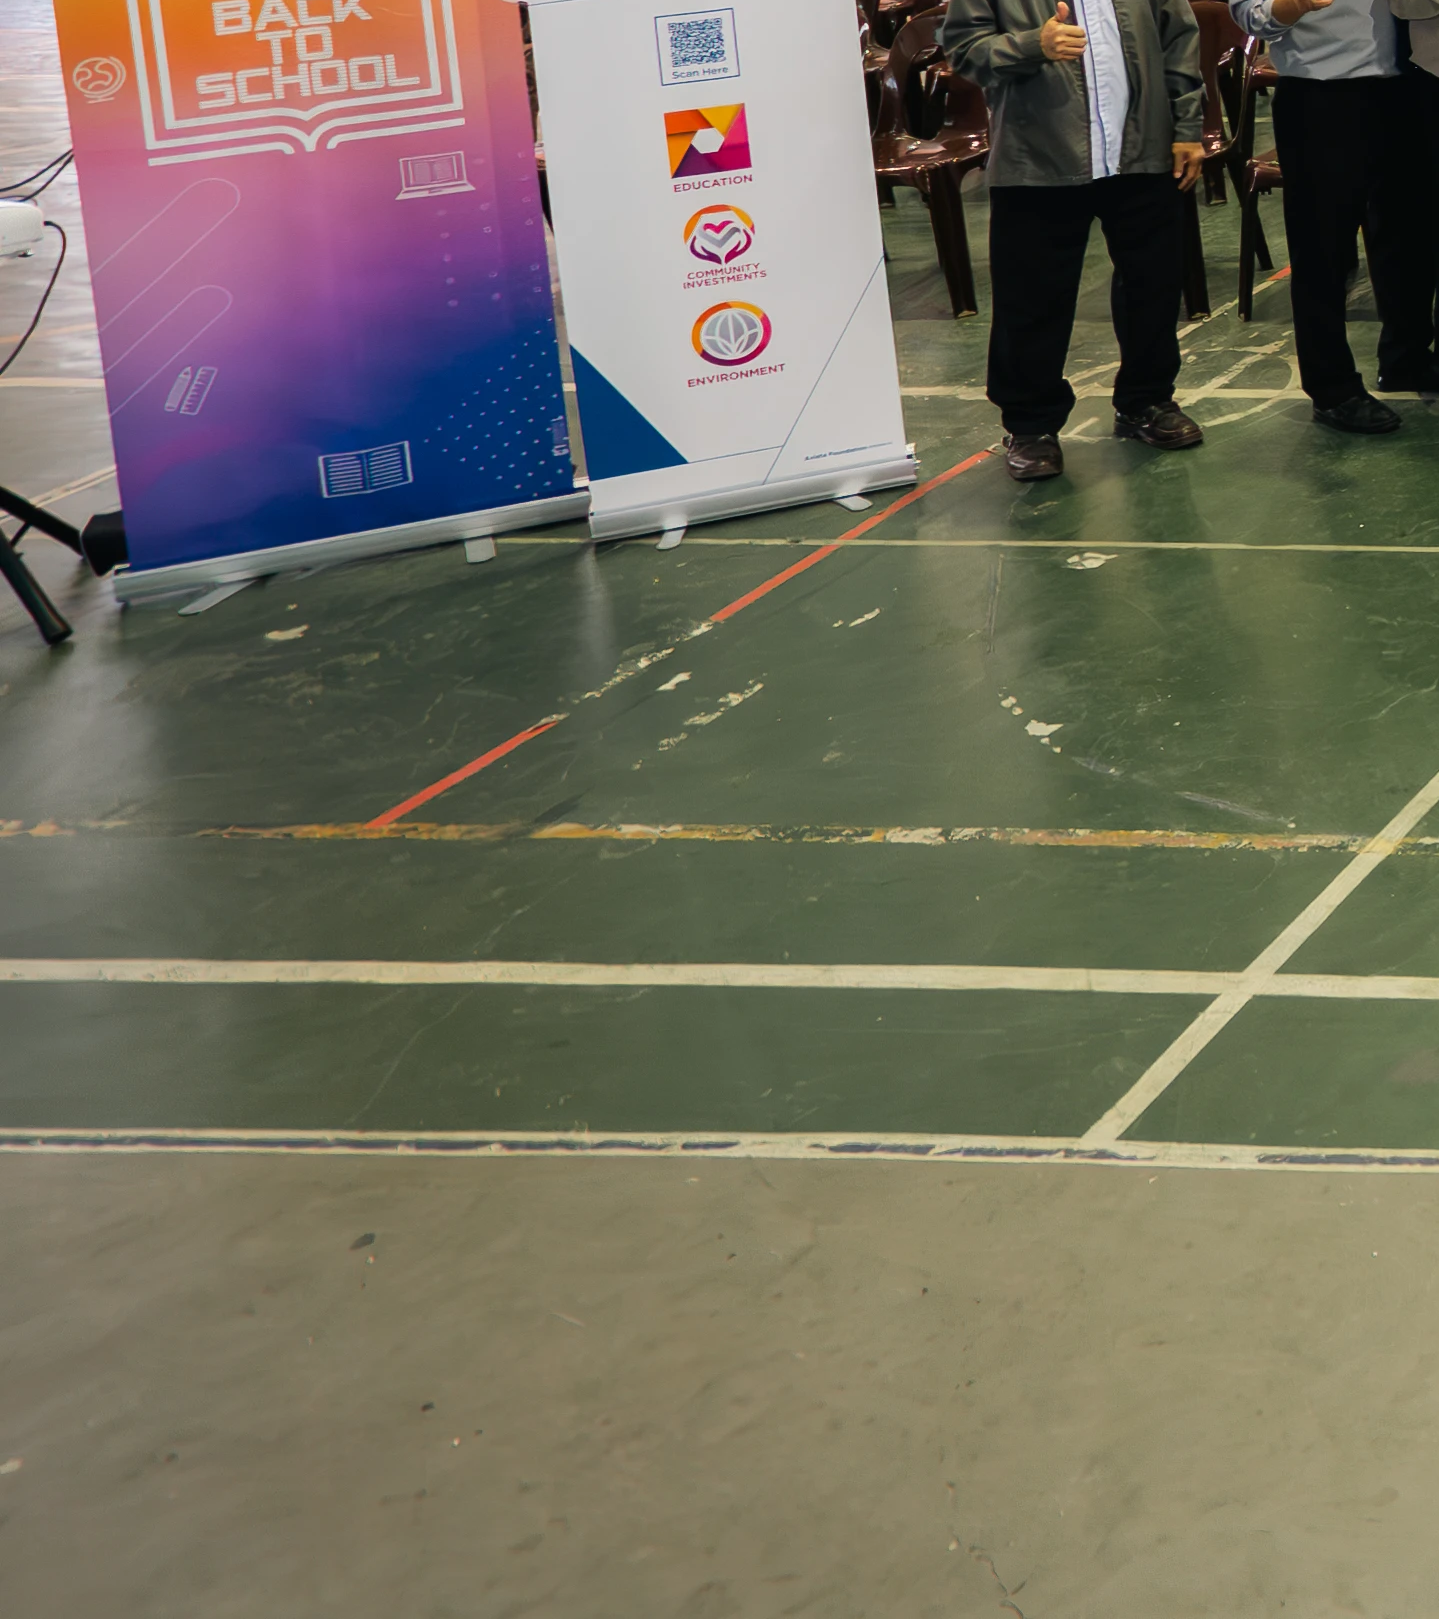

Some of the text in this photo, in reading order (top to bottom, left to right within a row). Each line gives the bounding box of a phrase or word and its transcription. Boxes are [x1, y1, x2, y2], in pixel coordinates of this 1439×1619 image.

[255, 26, 334, 65] TO
[195, 54, 420, 109] SCHOOL
[672, 66, 729, 79] Scan Here
[673, 174, 753, 193] EDUCATION
[683, 270, 767, 289] INVESTMENTS
[687, 263, 760, 280] COMMUNITY
[687, 363, 785, 388] ENVIRONMENT
